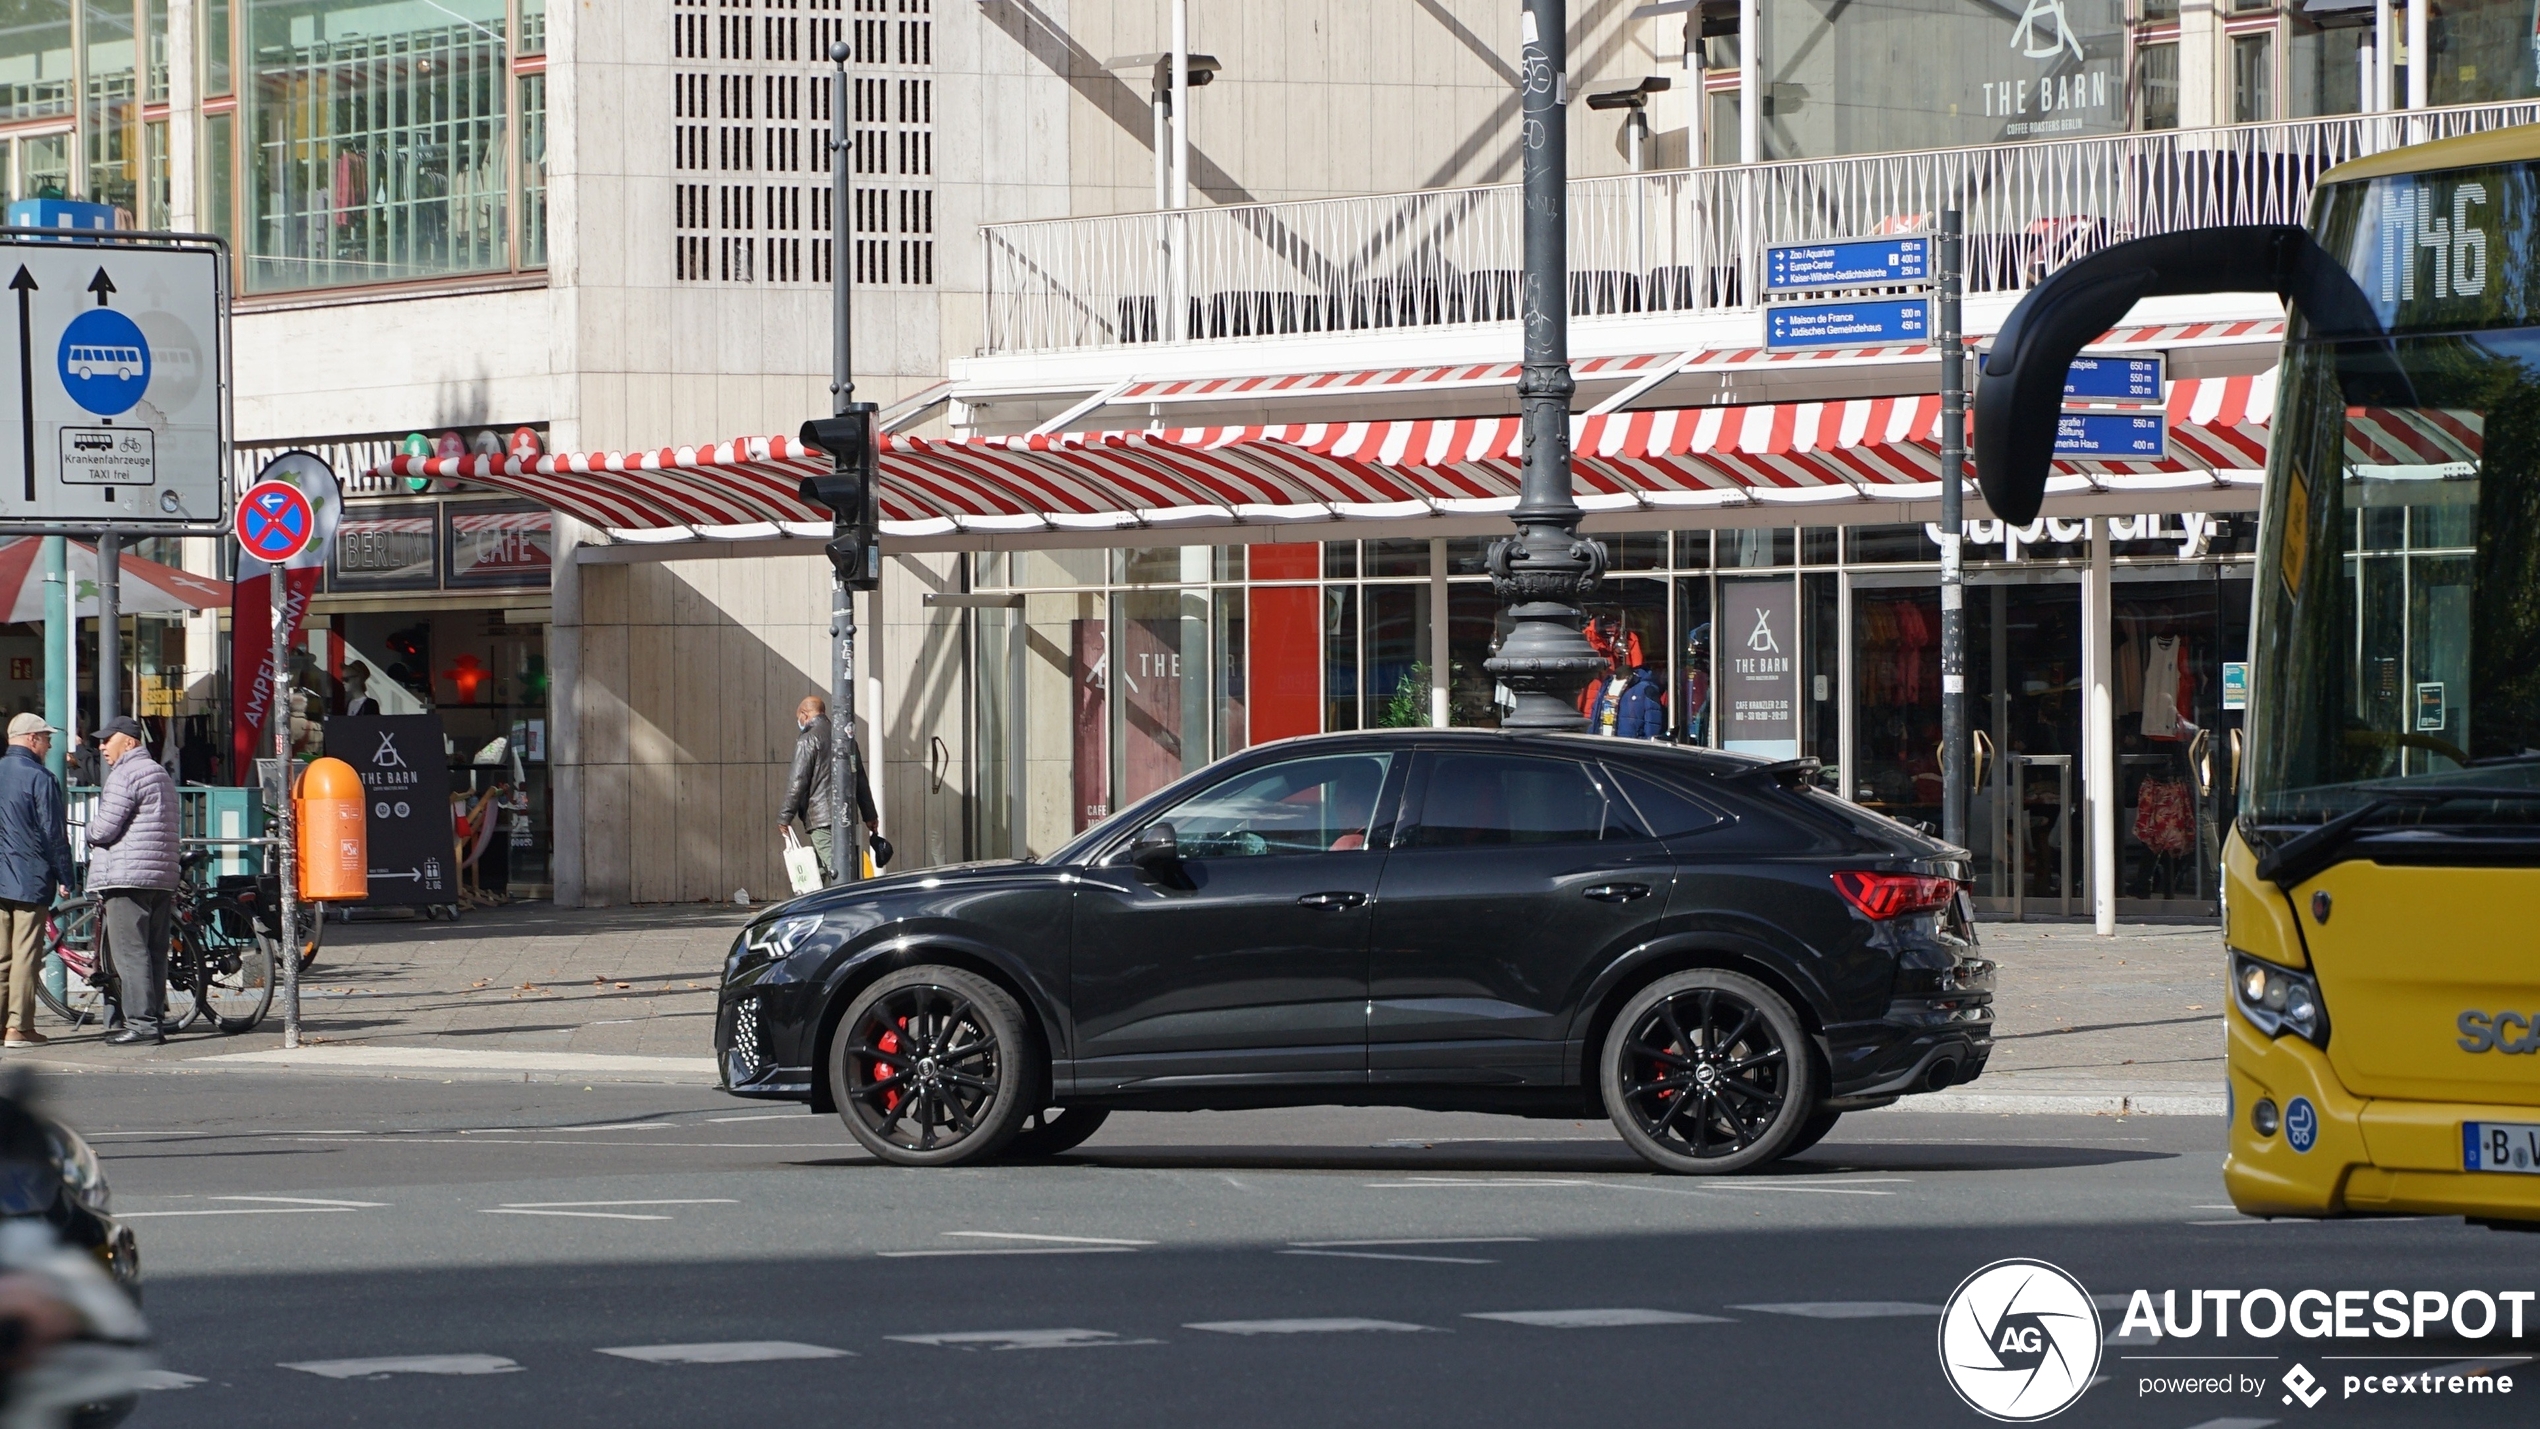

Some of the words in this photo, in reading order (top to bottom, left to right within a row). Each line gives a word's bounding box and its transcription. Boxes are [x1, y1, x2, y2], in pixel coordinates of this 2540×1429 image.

[1983, 80, 2026, 116] THE
[2041, 71, 2105, 111] BARN
[2006, 122, 2028, 135] COFFEE
[2029, 120, 2060, 133] ROASTERS
[2061, 118, 2083, 131] BERLIN
[2381, 183, 2487, 302] M46
[1789, 250, 1803, 260] Zoo
[1806, 249, 1835, 259] Aquarium
[1901, 242, 1913, 251] 650
[1789, 261, 1833, 272] Europa-Center
[1901, 255, 1913, 263] 400
[1789, 269, 1887, 283] Kaiser-Wilhelm-Gedächtniskirche
[1901, 266, 1913, 275] 250
[1789, 315, 1816, 325] Maison
[1817, 315, 1826, 323] de
[1828, 313, 1854, 323] France
[1901, 309, 1913, 318] 500
[1789, 326, 1826, 337] Jüdisches
[1827, 324, 1882, 335] Gemeindehaus
[1901, 321, 1913, 330] 450
[2130, 362, 2143, 370] 650
[2130, 373, 2143, 383] 550
[2130, 385, 2143, 394] 300
[2133, 419, 2146, 428] 550
[2080, 440, 2099, 449] Haus
[2133, 440, 2146, 450] 400
[65, 454, 151, 467] Krankenfahrzeuge
[89, 469, 110, 479] TAXI
[114, 470, 130, 480] frei
[345, 530, 423, 568] BERLIN
[1139, 653, 1180, 678] THE
[1735, 658, 1755, 673] THE
[1760, 657, 1789, 673] BARN
[1735, 700, 1748, 710] CAFE
[361, 772, 383, 785] THE
[388, 771, 419, 785] BARN
[1087, 805, 1107, 816] CAFE
[2492, 1128, 2509, 1165] B
